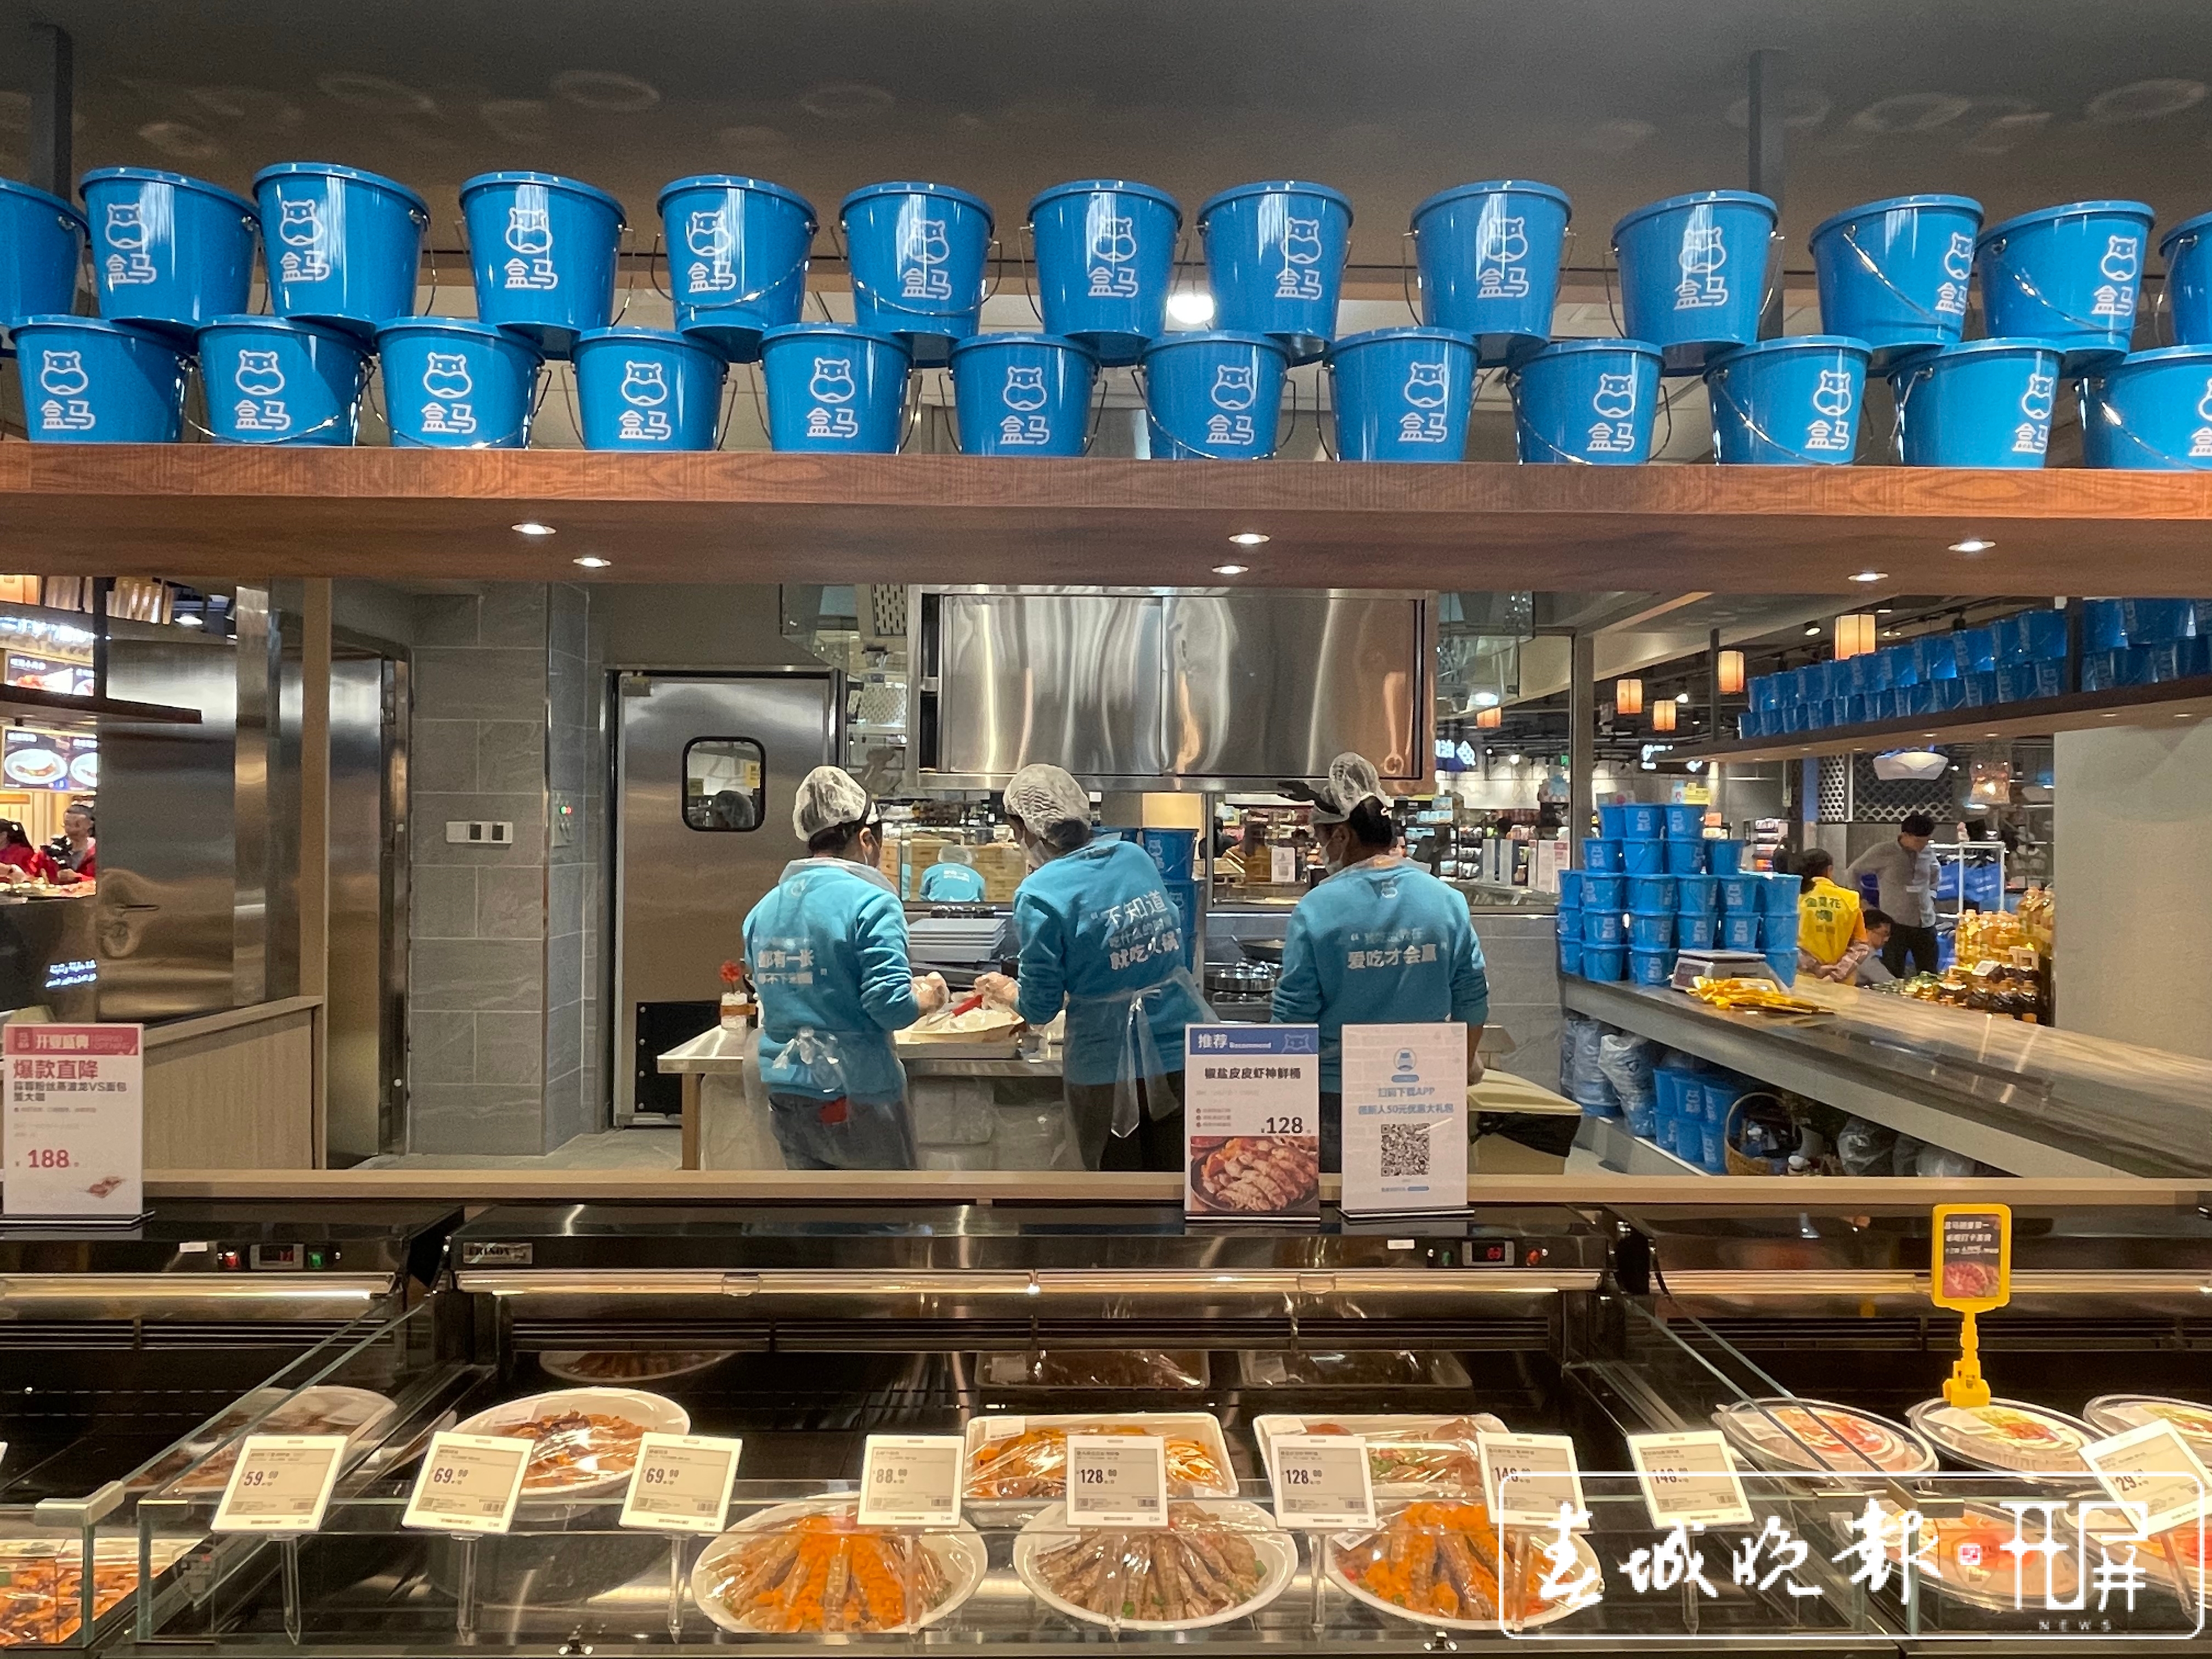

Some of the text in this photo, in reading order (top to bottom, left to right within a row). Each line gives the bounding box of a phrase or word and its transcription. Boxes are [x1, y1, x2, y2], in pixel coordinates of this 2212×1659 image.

[106, 253, 157, 284] 盒马
[280, 251, 330, 283] 盒马
[504, 257, 558, 290] 盒马
[688, 261, 737, 293] 盒马
[1087, 267, 1139, 298] 盒马
[1477, 267, 1530, 298] 盒马
[901, 266, 952, 301] 盒马
[1275, 267, 1323, 301] 盒马
[1674, 276, 1729, 310] 盒马
[1935, 282, 1967, 315] 盒马
[2091, 284, 2135, 317] 盒马
[41, 398, 95, 430] 盒马
[234, 399, 291, 431] 盒马
[421, 401, 477, 434] 盒马
[618, 409, 672, 441] 盒马
[806, 407, 858, 438] 盒马
[1206, 414, 1255, 445] 盒马
[1398, 412, 1448, 443] 盒马
[1000, 415, 1050, 446] 盒马
[1587, 422, 1635, 453] 盒马
[1805, 420, 1850, 450] 盒马
[2012, 422, 2049, 453] 盒马
[1101, 889, 1168, 929] 不知道
[1198, 1033, 1227, 1048] 推荐
[14, 1060, 98, 1079] 爆款直降
